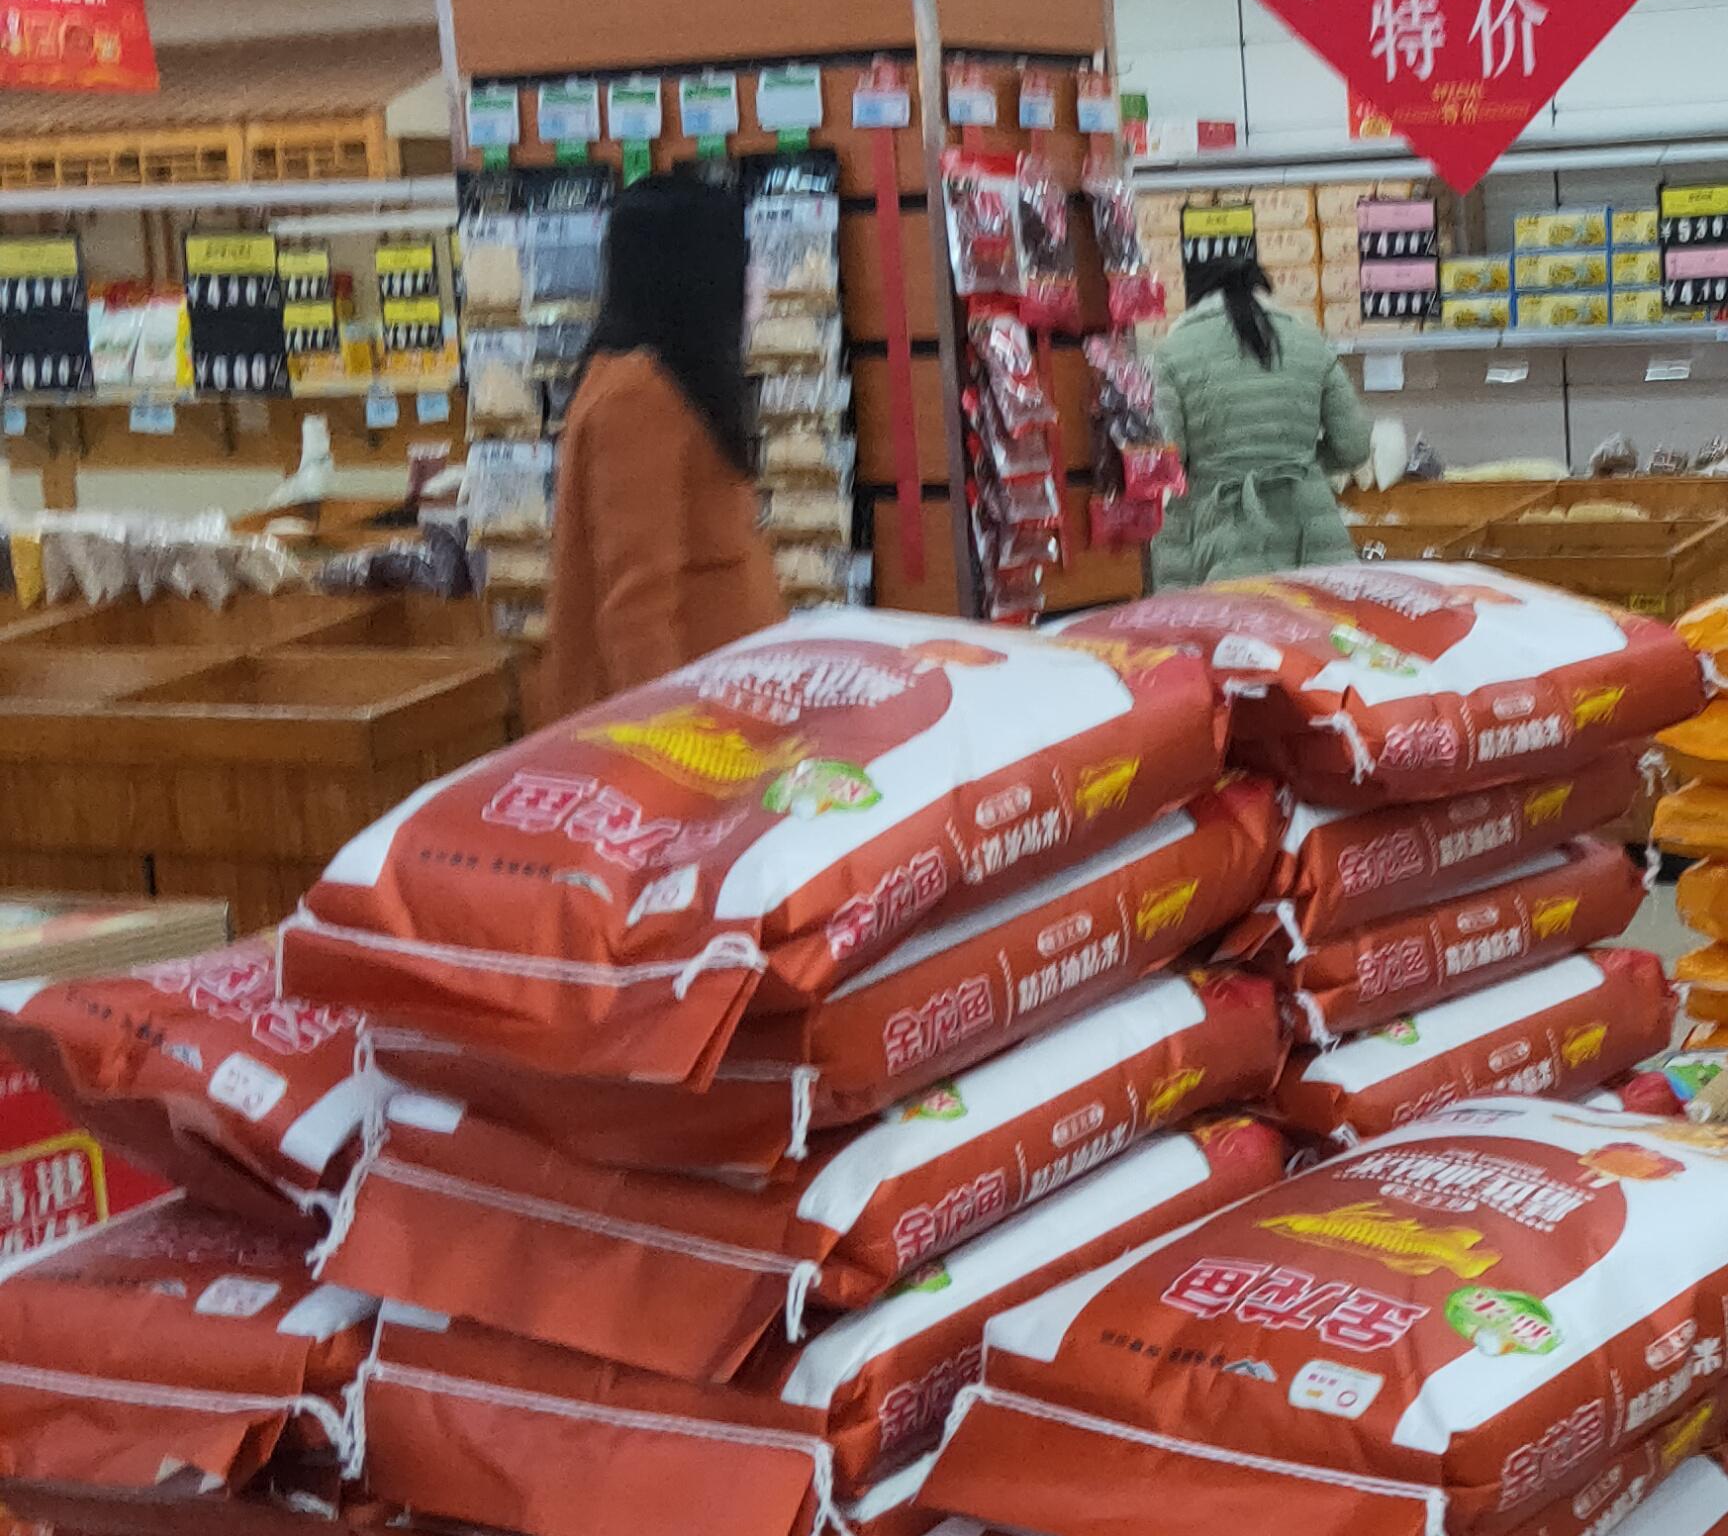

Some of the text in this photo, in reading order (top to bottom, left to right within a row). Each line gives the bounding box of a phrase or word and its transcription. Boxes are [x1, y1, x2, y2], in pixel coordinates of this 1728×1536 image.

[825, 844, 949, 960] 金龙鱼
[883, 972, 996, 1077] 金龙鱼
[892, 1167, 1006, 1264] 金龙鱼
[1160, 1256, 1432, 1355] 金龙鱼
